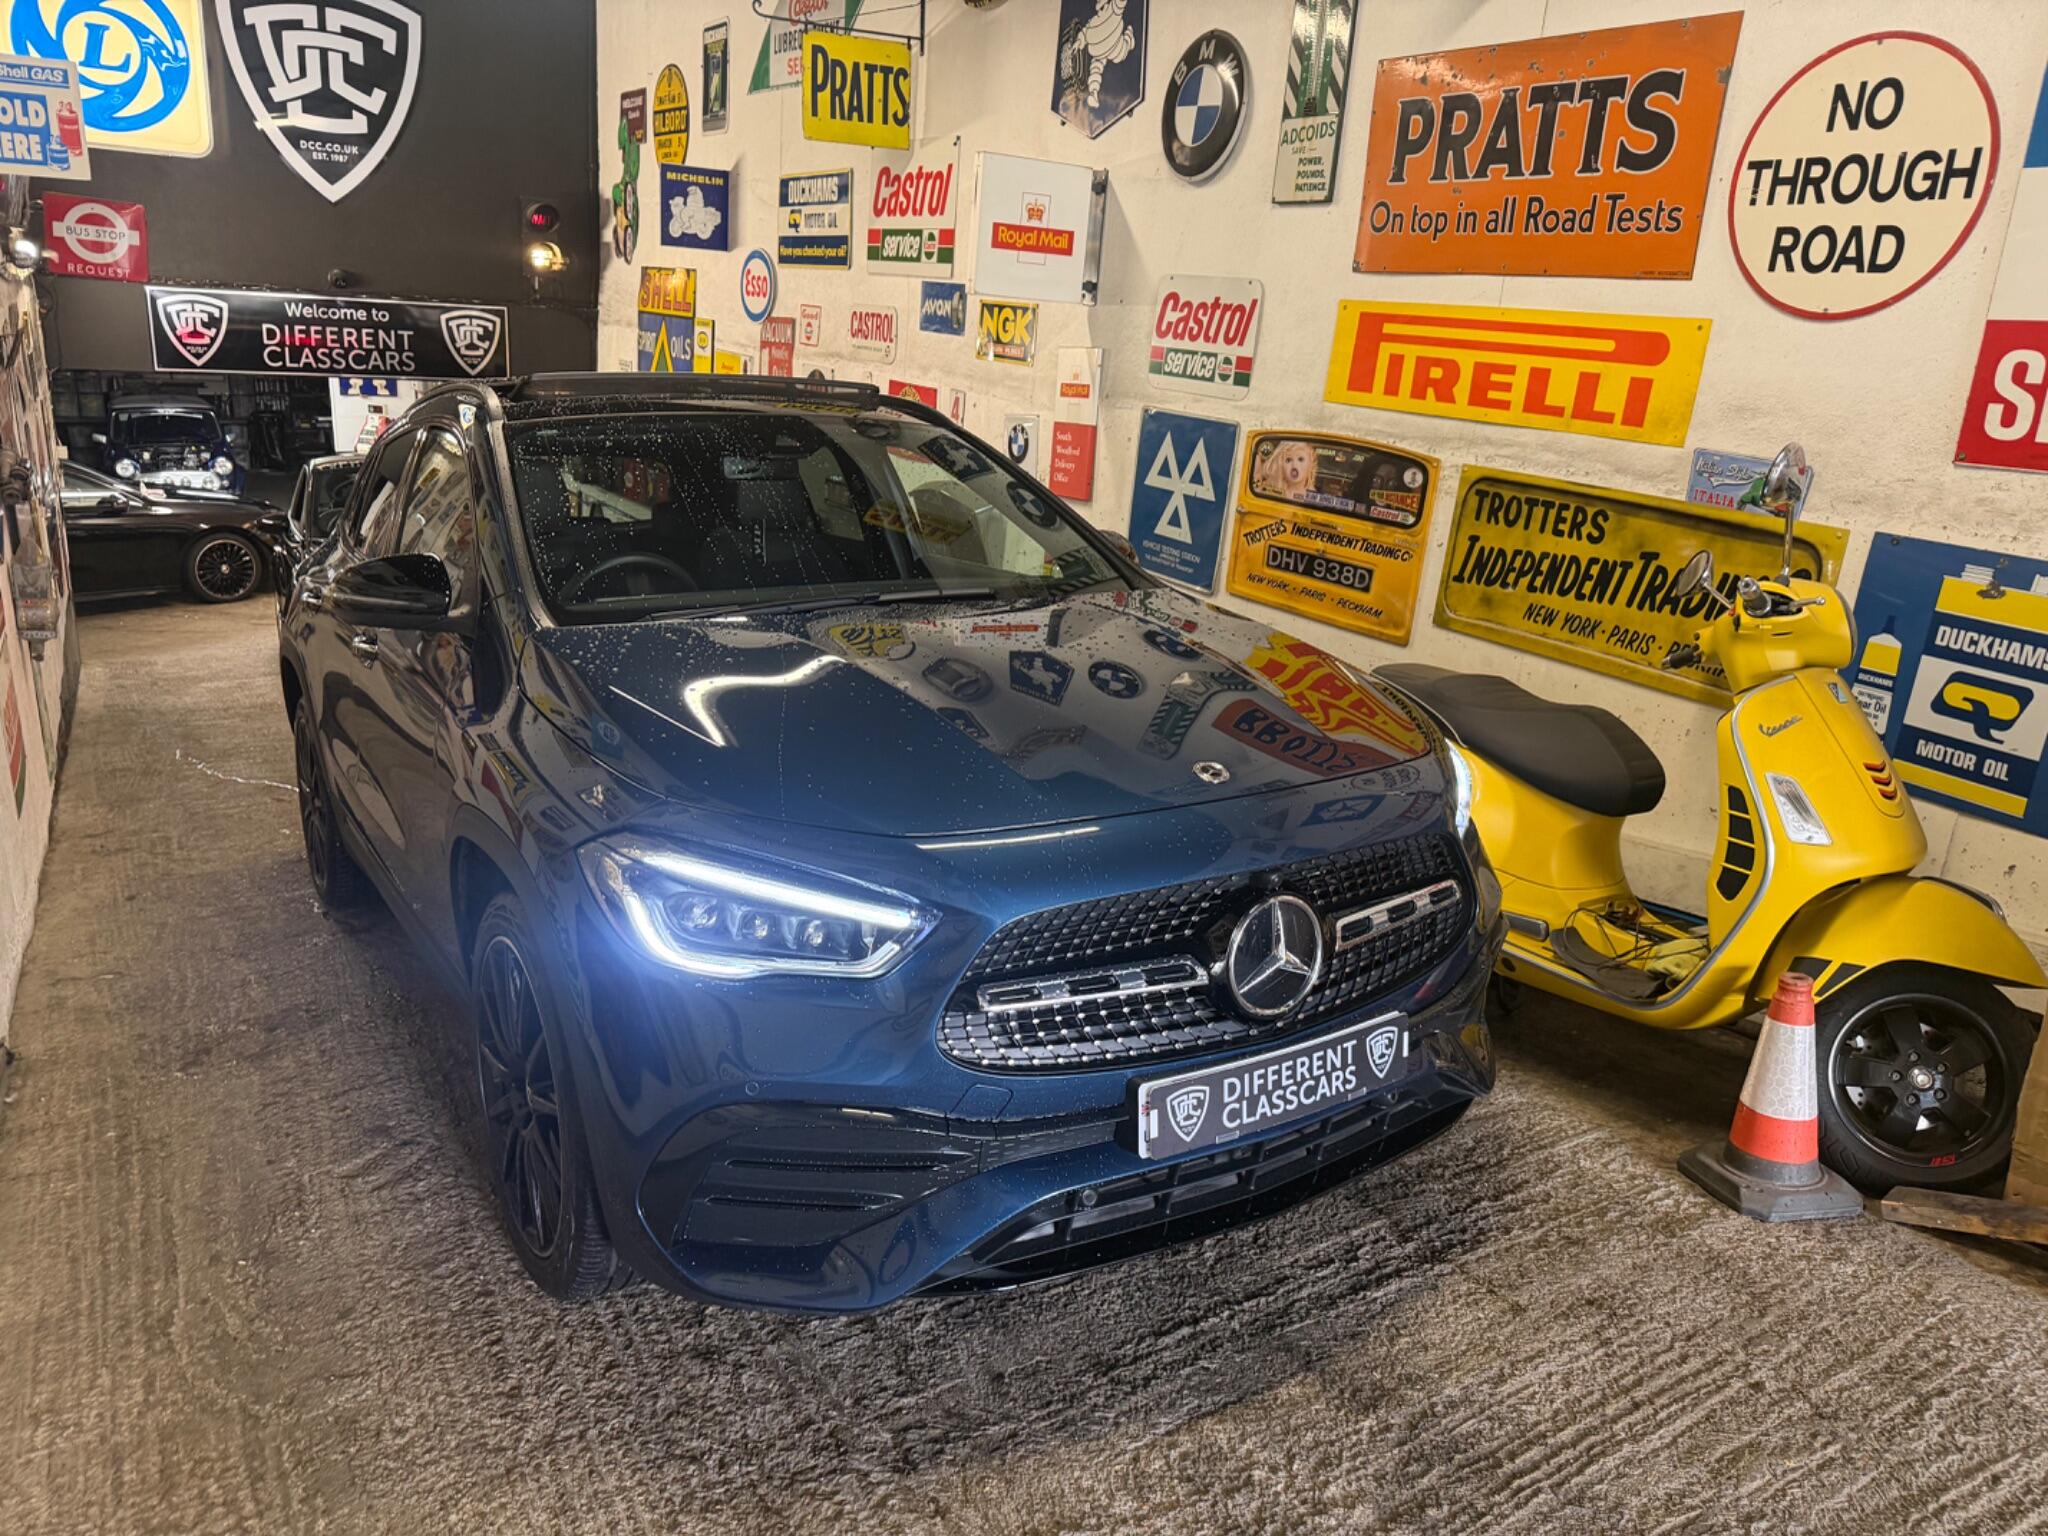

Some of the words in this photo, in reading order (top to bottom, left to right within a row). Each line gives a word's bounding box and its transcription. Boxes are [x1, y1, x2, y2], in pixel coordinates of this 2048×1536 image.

[79, 22, 131, 73] L
[1174, 38, 1239, 86] BMW
[31, 67, 64, 82] GAS
[811, 44, 910, 127] PRATTS
[1826, 77, 1904, 133] NO
[1281, 121, 1336, 146] ADCOIDS
[1387, 68, 1686, 185] PRATTS
[0, 132, 43, 161] ERE
[300, 140, 359, 155] DCC.CO.UK
[312, 152, 329, 161] EST.
[331, 153, 348, 162] 1987
[666, 171, 724, 186] MICHELIN
[788, 176, 839, 204] DUCKHAMS
[873, 164, 953, 218] Castrol
[1747, 147, 1983, 206] THROUGH
[65, 225, 91, 237] BUS
[94, 228, 126, 241] STOP
[1370, 201, 1404, 234] On
[1410, 205, 1448, 242] top
[1455, 202, 1478, 234] in
[1485, 195, 1517, 234] all
[1523, 193, 1598, 234] Road
[1604, 193, 1683, 234] Tests
[882, 234, 920, 258] service
[998, 226, 1036, 247] Royal
[1040, 231, 1069, 249] Mail
[1768, 224, 1905, 274] ROAD
[67, 263, 130, 278] REQUEST
[745, 268, 768, 298] Esso
[641, 269, 692, 313] SHELL
[285, 302, 368, 321] Welcome
[372, 306, 390, 321] to
[922, 298, 952, 317] AVON
[1156, 291, 1258, 347] Castrol
[262, 323, 414, 350] DIFFERENT
[851, 310, 894, 343] CASTROL
[981, 306, 1033, 346] NGK
[263, 346, 416, 372] CLASSCARS
[670, 336, 691, 360] OILS
[1164, 351, 1215, 378] service
[1347, 311, 1670, 428] PIRELLI
[951, 396, 960, 423] 4
[1056, 431, 1072, 441] South
[1054, 459, 1075, 472] Delivery
[1694, 489, 1735, 508] ITALIA
[1473, 489, 1609, 545] TROTTERS
[1243, 519, 1287, 546] TROTTERS
[1291, 523, 1360, 551] INDEPENDENT
[1359, 539, 1401, 560] TRADING
[1268, 547, 1310, 572] DHV
[1313, 559, 1370, 589] 938D
[1453, 534, 1634, 611] INDEPENDENT
[1247, 573, 1266, 586] NEW
[1267, 578, 1290, 592] YORK
[1299, 586, 1326, 603] PARIS
[1336, 598, 1384, 618] PECKHAM
[1523, 602, 1559, 627] NEW
[1561, 614, 1598, 638] YORK
[1604, 626, 1656, 657] PARIS
[1874, 701, 1886, 714] Oil
[1916, 738, 1977, 771] MOTOR
[1983, 757, 2009, 781] OIL
[1223, 1040, 1357, 1104] DIFFERENT
[1223, 1067, 1357, 1128] CLASSCARS
